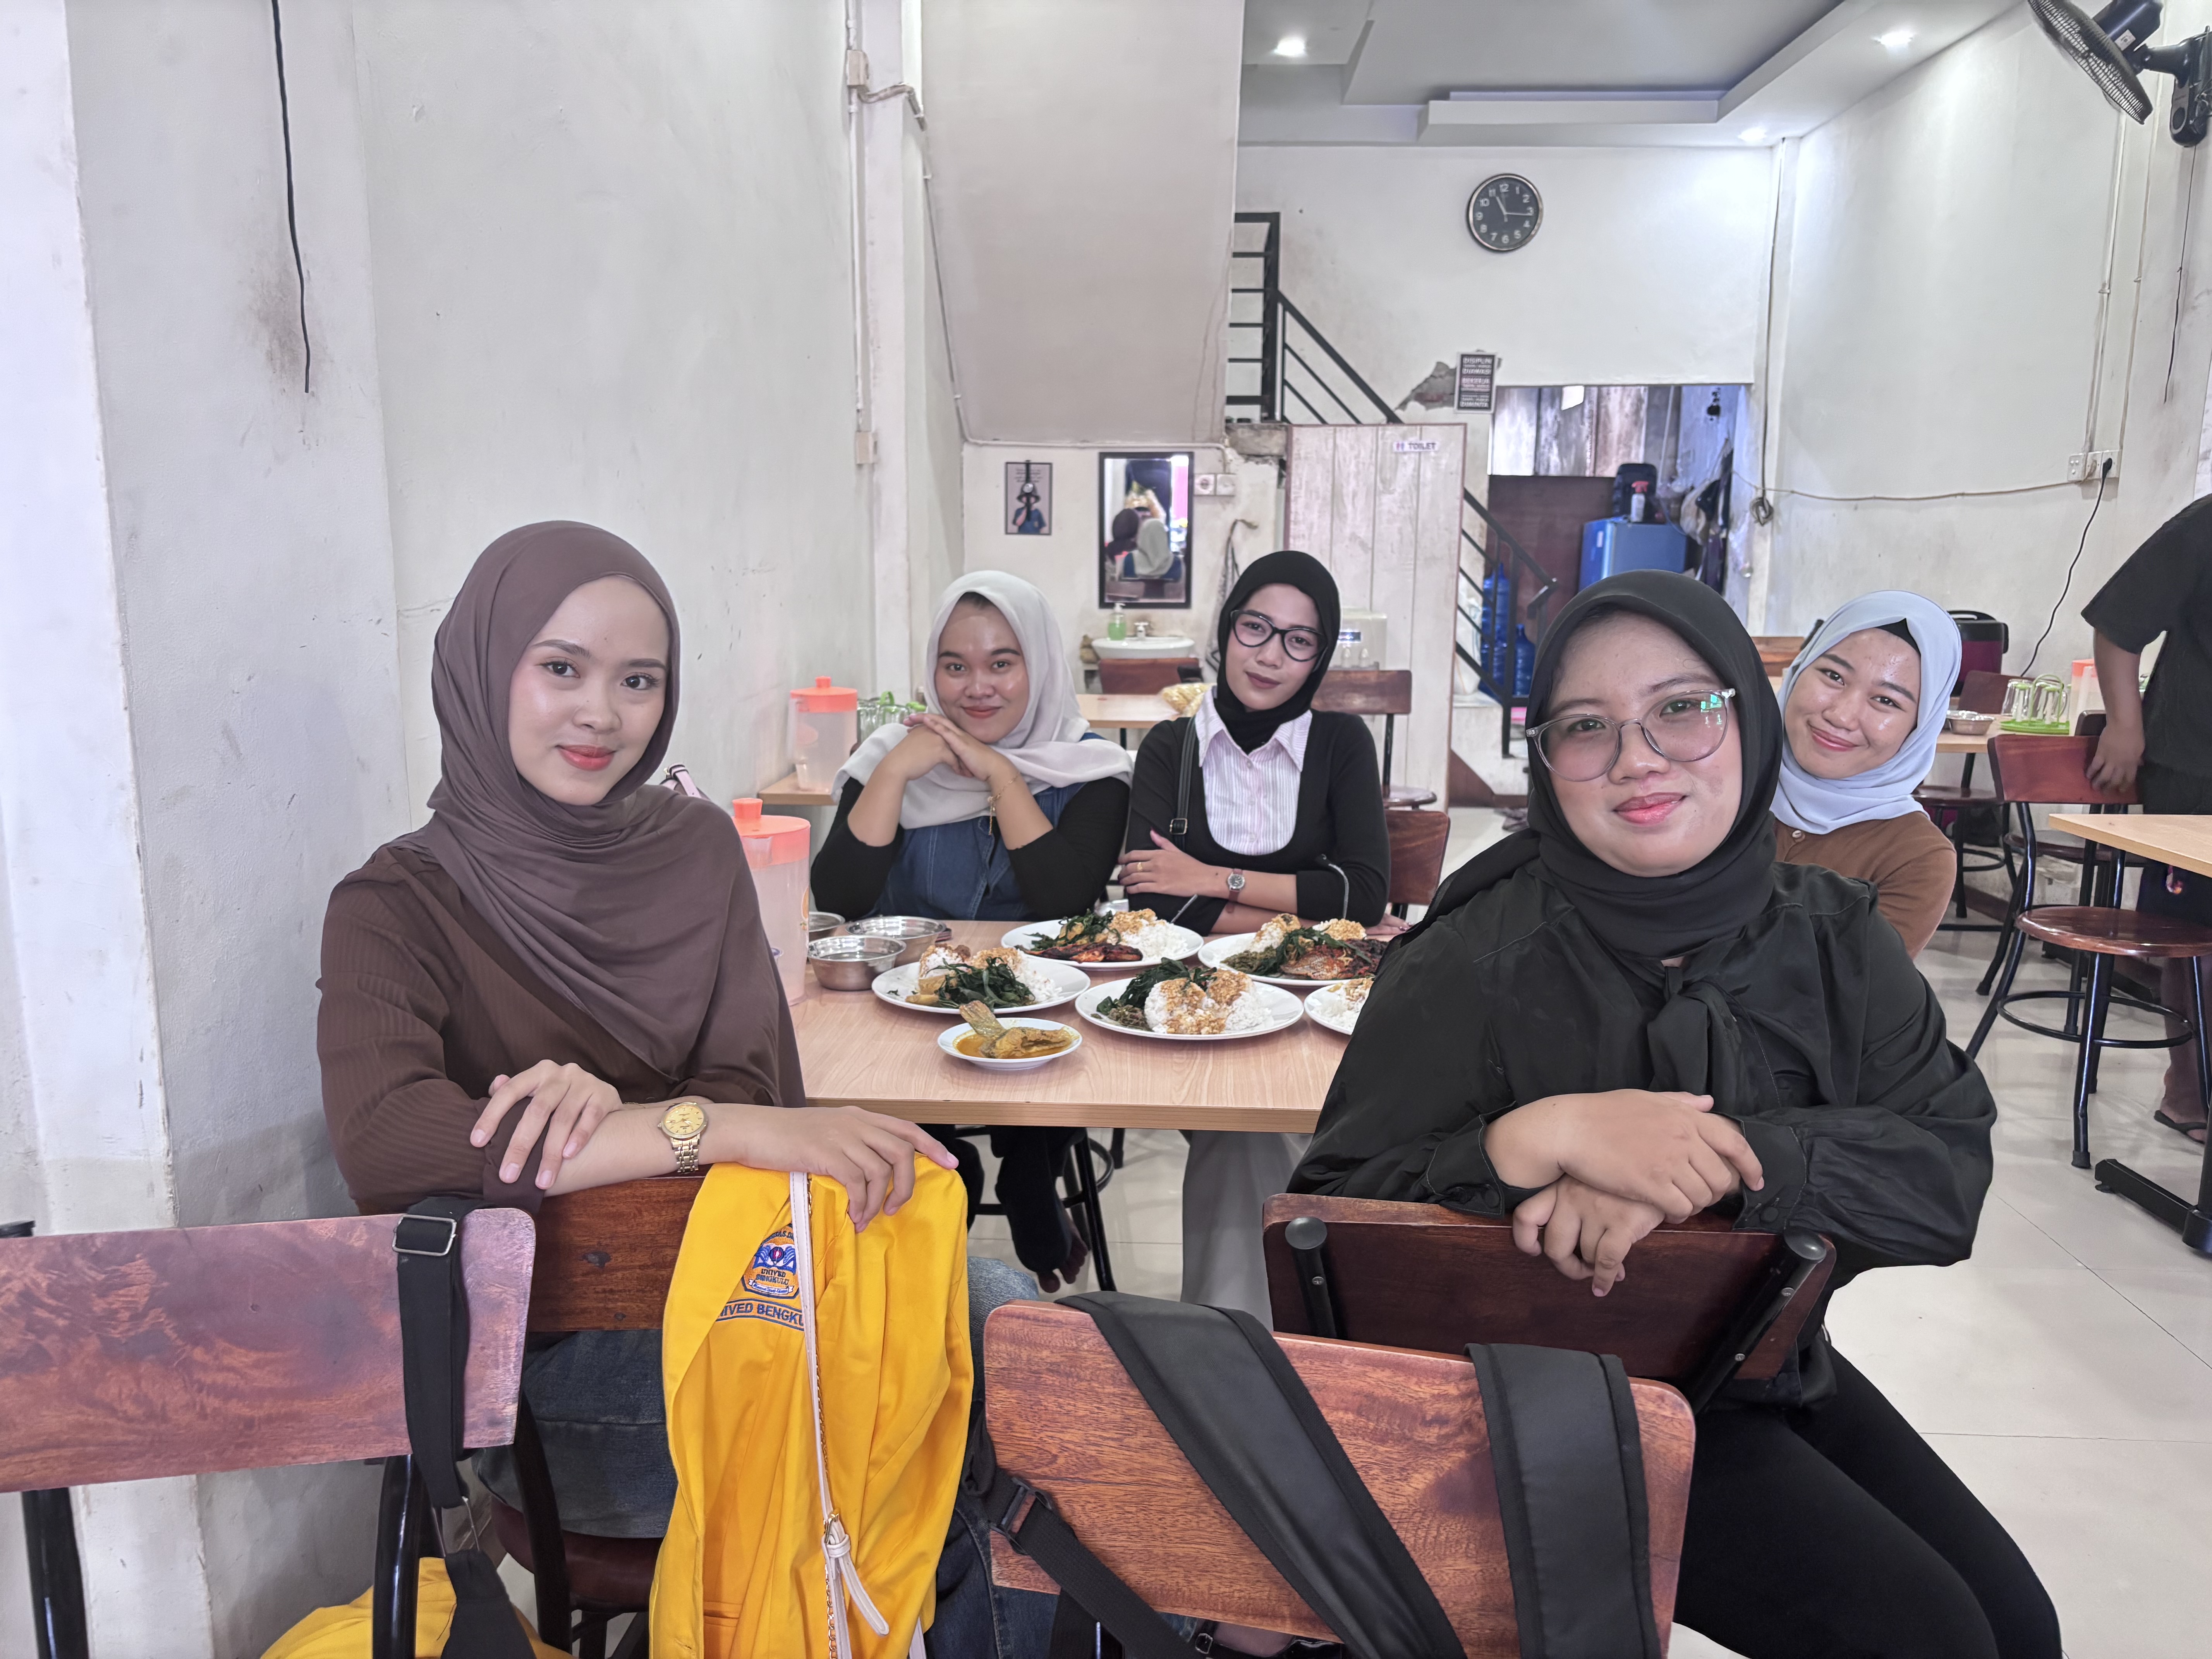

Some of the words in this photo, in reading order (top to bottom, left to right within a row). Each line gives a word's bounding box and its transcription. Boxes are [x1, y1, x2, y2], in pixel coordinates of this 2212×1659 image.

[1489, 188, 1496, 197] 11
[1499, 184, 1509, 192] 12
[1516, 186, 1520, 194] 1
[1480, 198, 1490, 207] 10
[1522, 194, 1530, 203] 2
[1527, 206, 1534, 216] 3
[1475, 212, 1483, 220] 9
[1480, 224, 1487, 233] 8
[1490, 233, 1498, 241] 7
[1514, 229, 1522, 239] 5
[1501, 235, 1509, 244] 6
[720, 1303, 754, 1316] IVED
